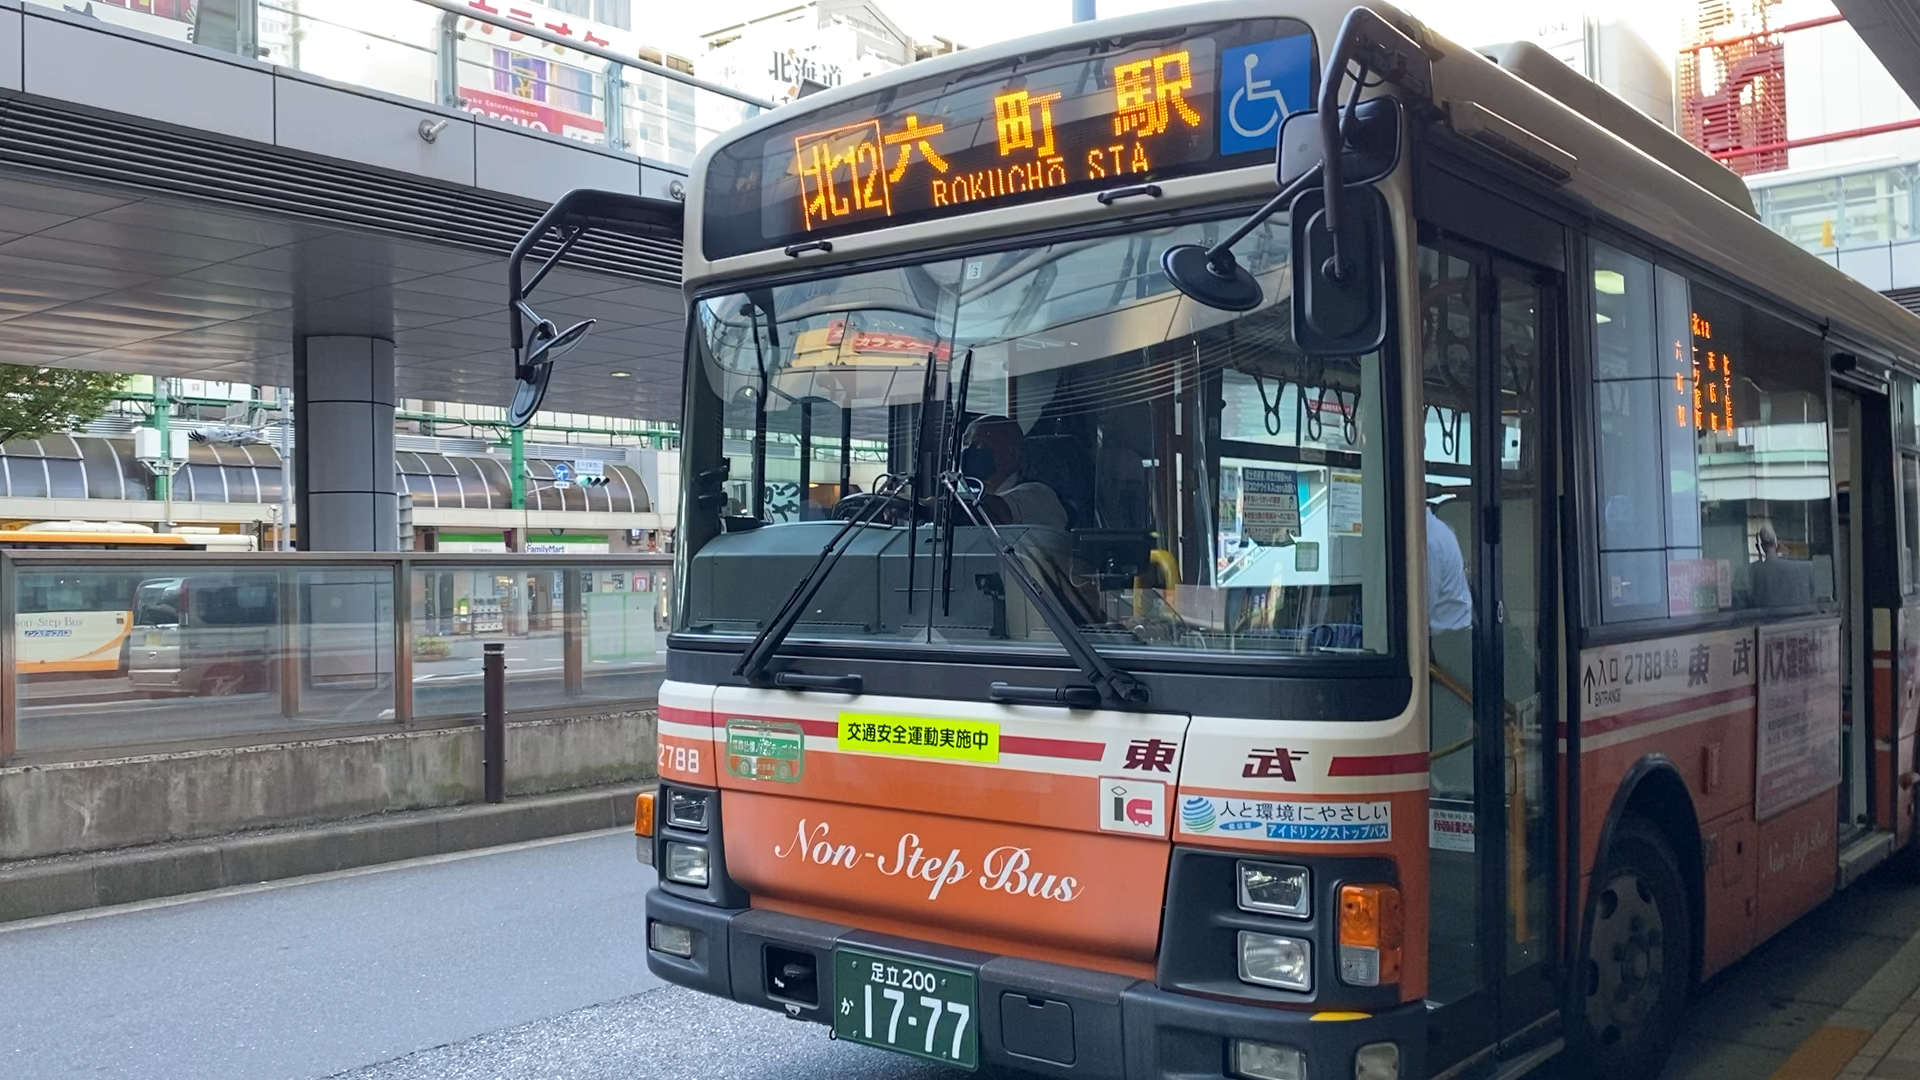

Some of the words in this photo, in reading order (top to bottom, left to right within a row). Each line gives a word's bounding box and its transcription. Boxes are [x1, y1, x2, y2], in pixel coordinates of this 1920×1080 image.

[1088, 142, 1150, 180] STA
[526, 544, 565, 553] FamilyMart
[1598, 658, 1619, 687] 入口
[1625, 650, 1662, 685] 2788
[1687, 637, 1753, 688] 東武
[1595, 688, 1621, 707] ENTRANCE
[847, 722, 989, 751] 交通安全運動実施中
[658, 743, 700, 774] 2788
[1219, 800, 1388, 822] 人と環境にやさしい
[1267, 824, 1388, 840] アイドリングストップバス
[775, 818, 971, 900] Non-Step
[979, 845, 1085, 905] Bus
[871, 962, 936, 993] 足立200
[840, 997, 854, 1015] か
